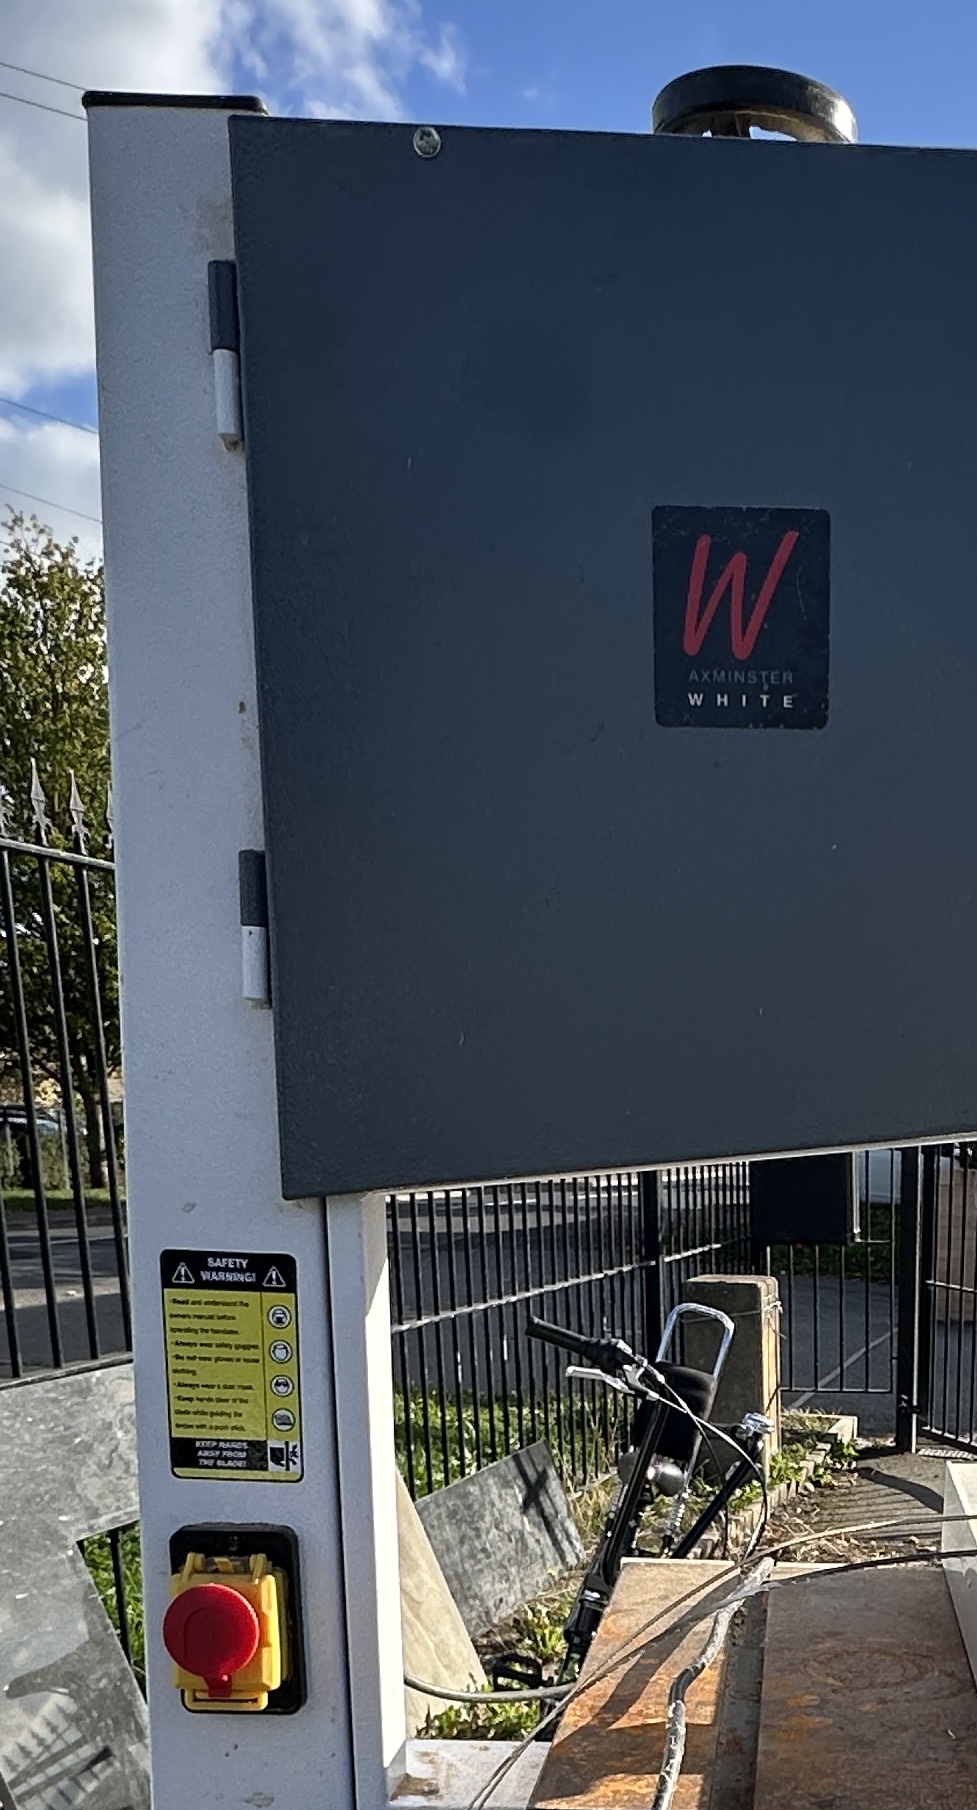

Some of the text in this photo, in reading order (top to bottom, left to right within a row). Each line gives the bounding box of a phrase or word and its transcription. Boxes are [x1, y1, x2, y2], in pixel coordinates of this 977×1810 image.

[682, 529, 800, 660] W
[688, 669, 794, 684] AXMINSTER
[687, 692, 794, 709] WHITE
[207, 1256, 249, 1270] SAFETY
[199, 1269, 257, 1283] WARNING!
